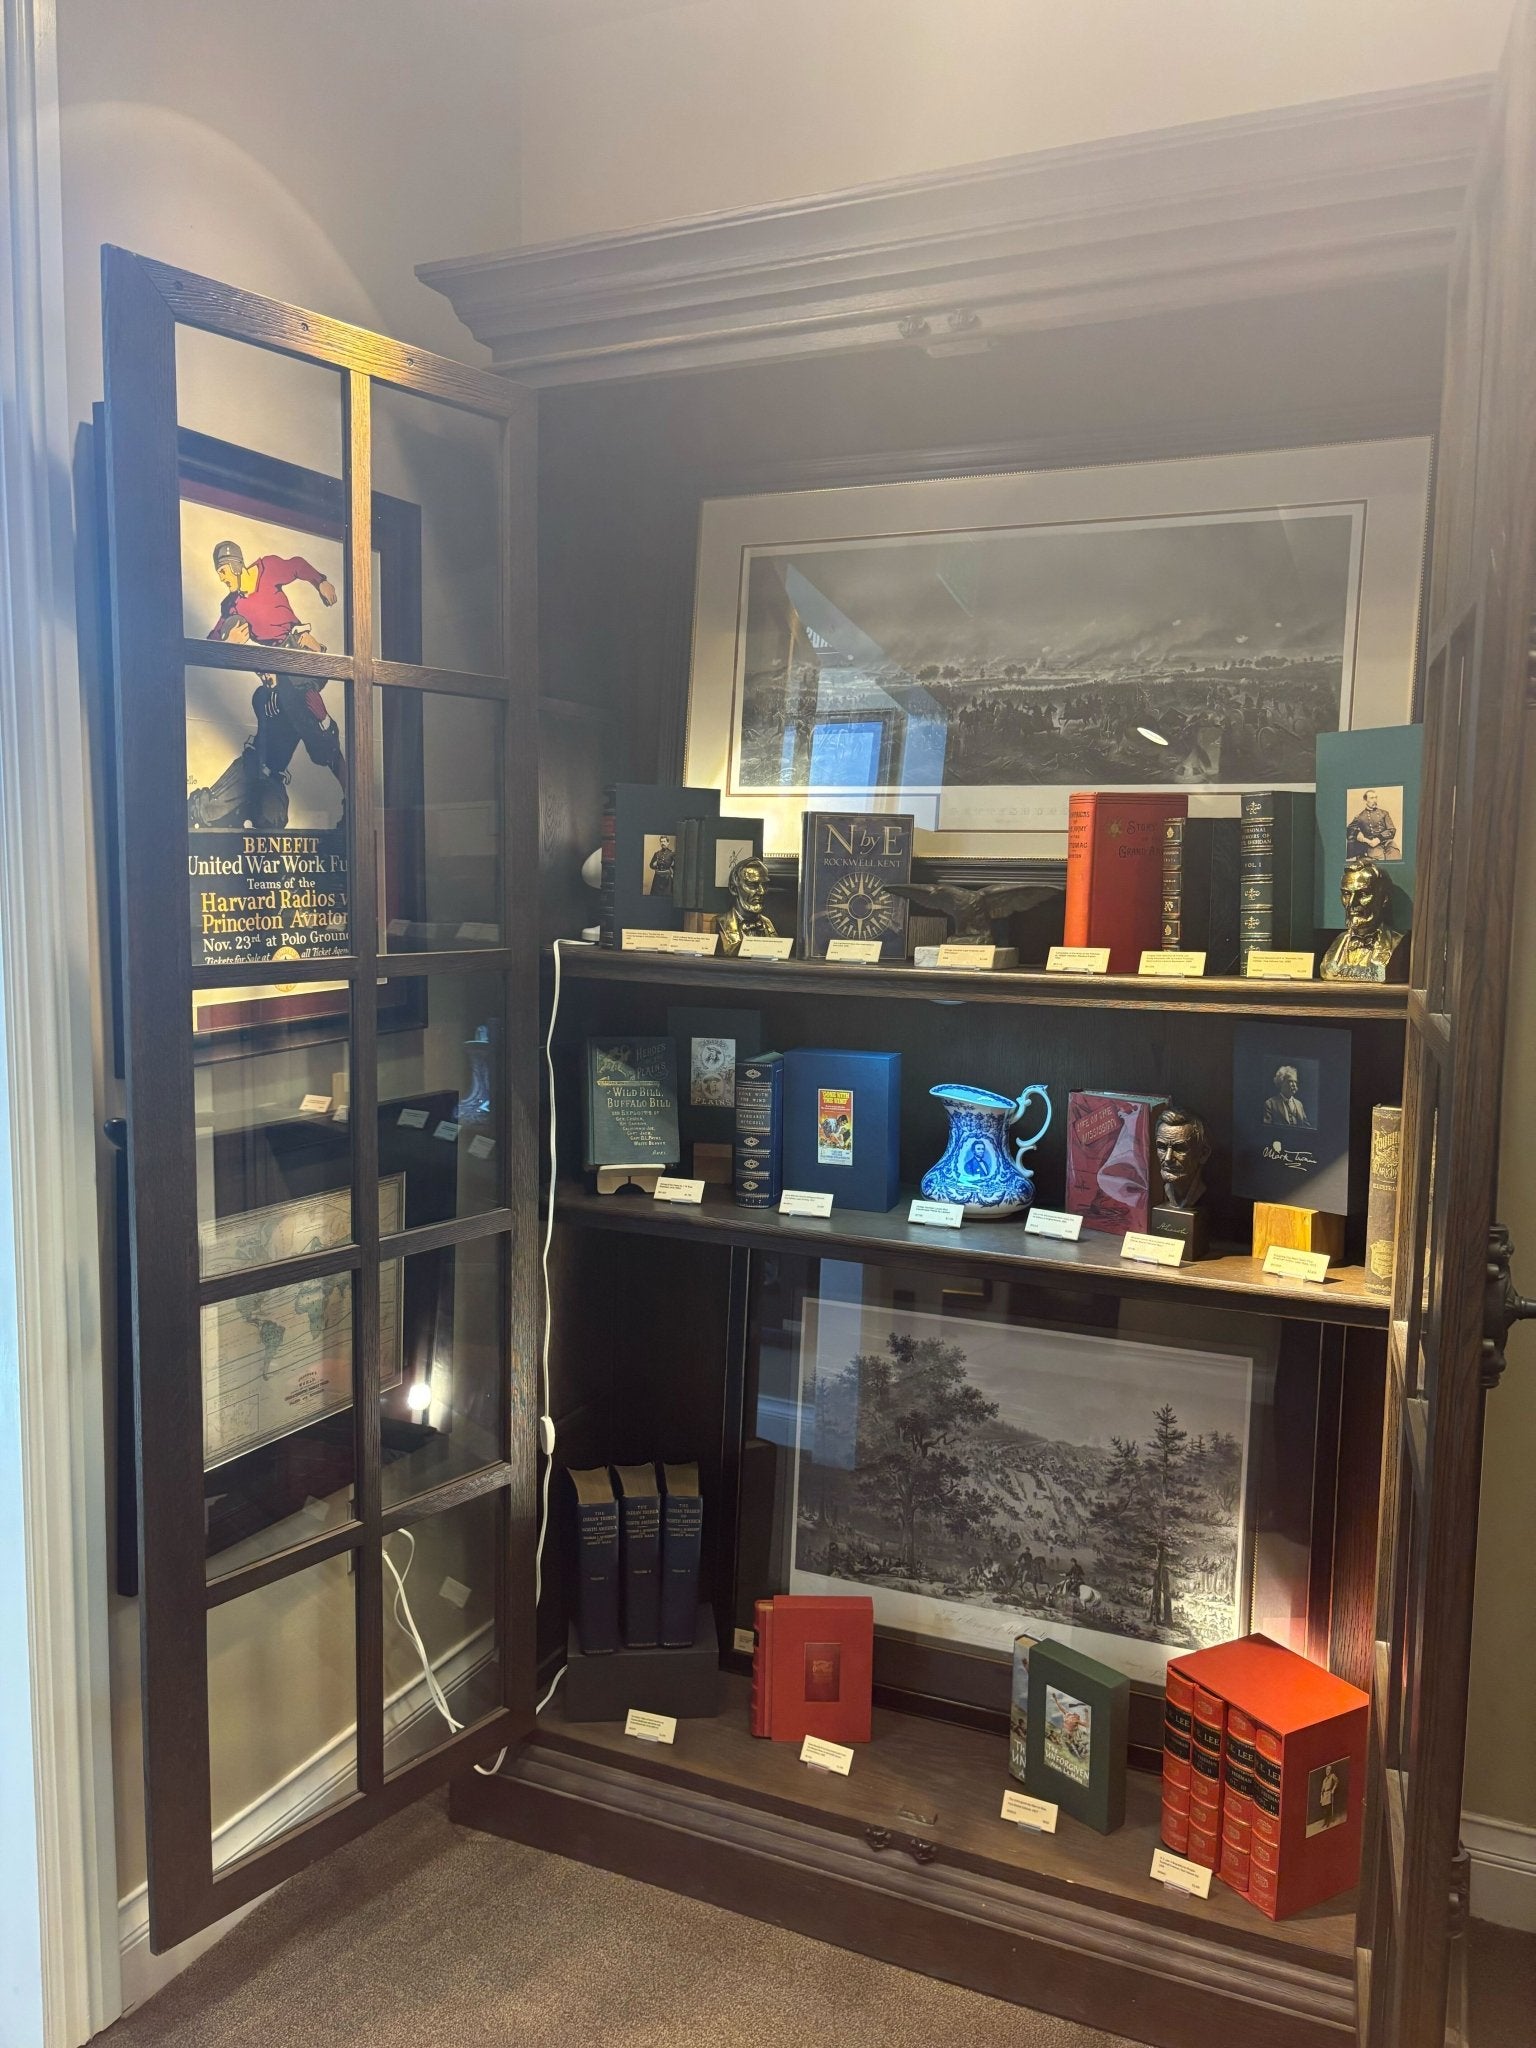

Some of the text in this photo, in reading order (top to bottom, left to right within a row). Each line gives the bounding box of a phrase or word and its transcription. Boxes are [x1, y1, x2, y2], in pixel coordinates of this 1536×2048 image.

[243, 836, 320, 854] BENEFIT
[824, 823, 903, 856] N by E
[188, 854, 244, 876] United
[244, 855, 280, 874] War
[280, 855, 327, 873] Work
[823, 858, 904, 868] ROCKWELL KENT
[246, 876, 316, 890] Teams of the
[200, 890, 276, 913] Harvard
[279, 889, 336, 909] Radios
[201, 912, 284, 935] Princeton
[202, 937, 233, 953] Nov.
[235, 933, 261, 950] 23rd
[265, 935, 278, 947] at
[281, 931, 307, 946] Polo
[300, 947, 311, 958] all
[311, 946, 332, 957] Ticket
[612, 1086, 638, 1097] WILD
[607, 1097, 672, 1108] BUFFALO BILL
[1175, 1714, 1191, 1728] LEE
[1013, 1738, 1026, 1754] TH
[1204, 1733, 1221, 1746] LEE
[1047, 1742, 1060, 1755] THE
[1237, 1749, 1254, 1761] LEE
[1045, 1749, 1090, 1780] UNFORGIVEN
